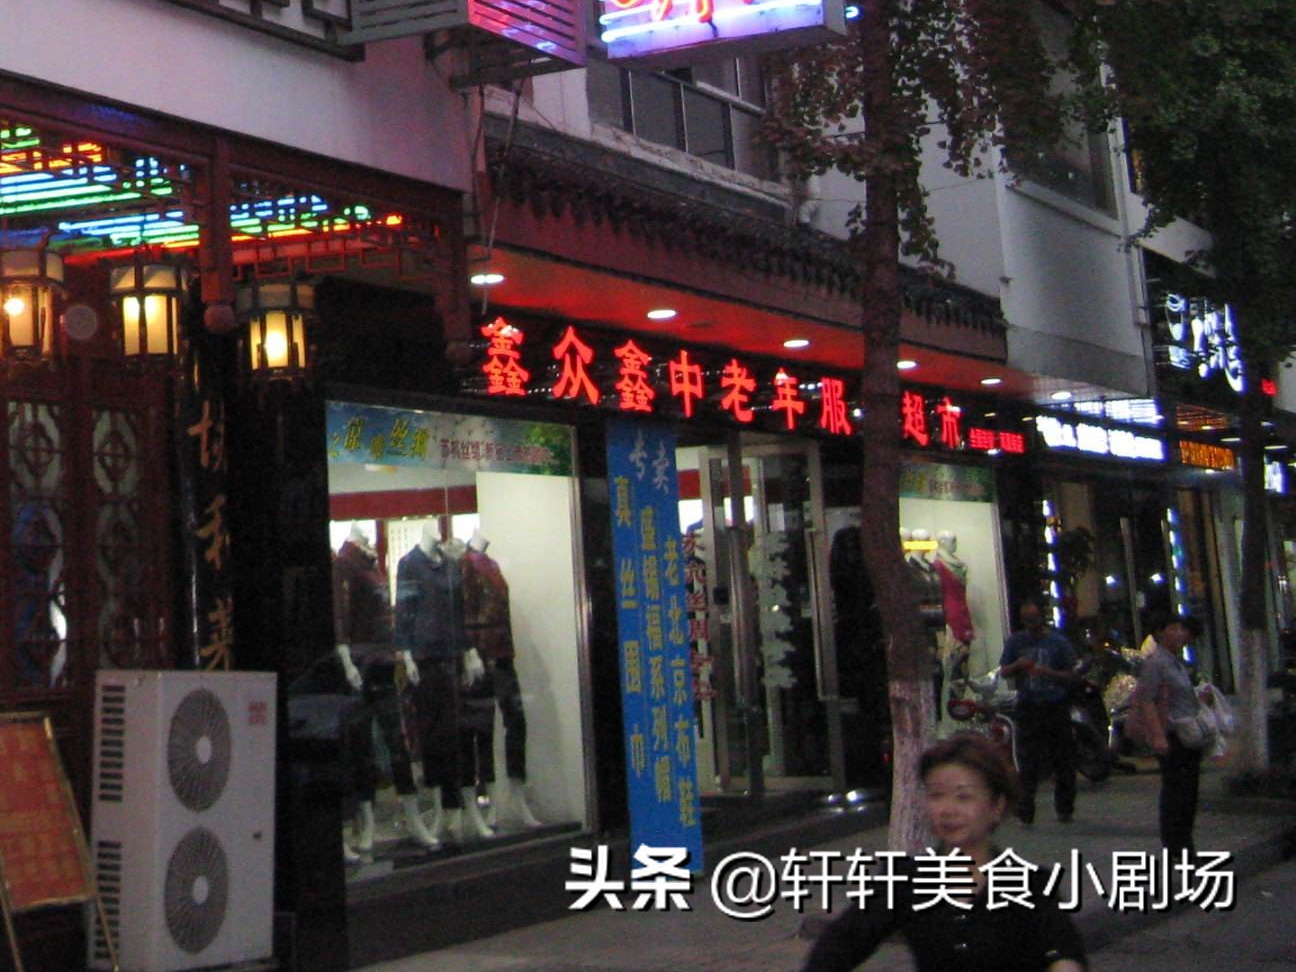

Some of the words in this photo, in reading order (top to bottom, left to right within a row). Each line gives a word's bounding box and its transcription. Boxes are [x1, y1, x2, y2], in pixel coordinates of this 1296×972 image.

[481, 315, 964, 449] 鑫众鑫中老年服超市
